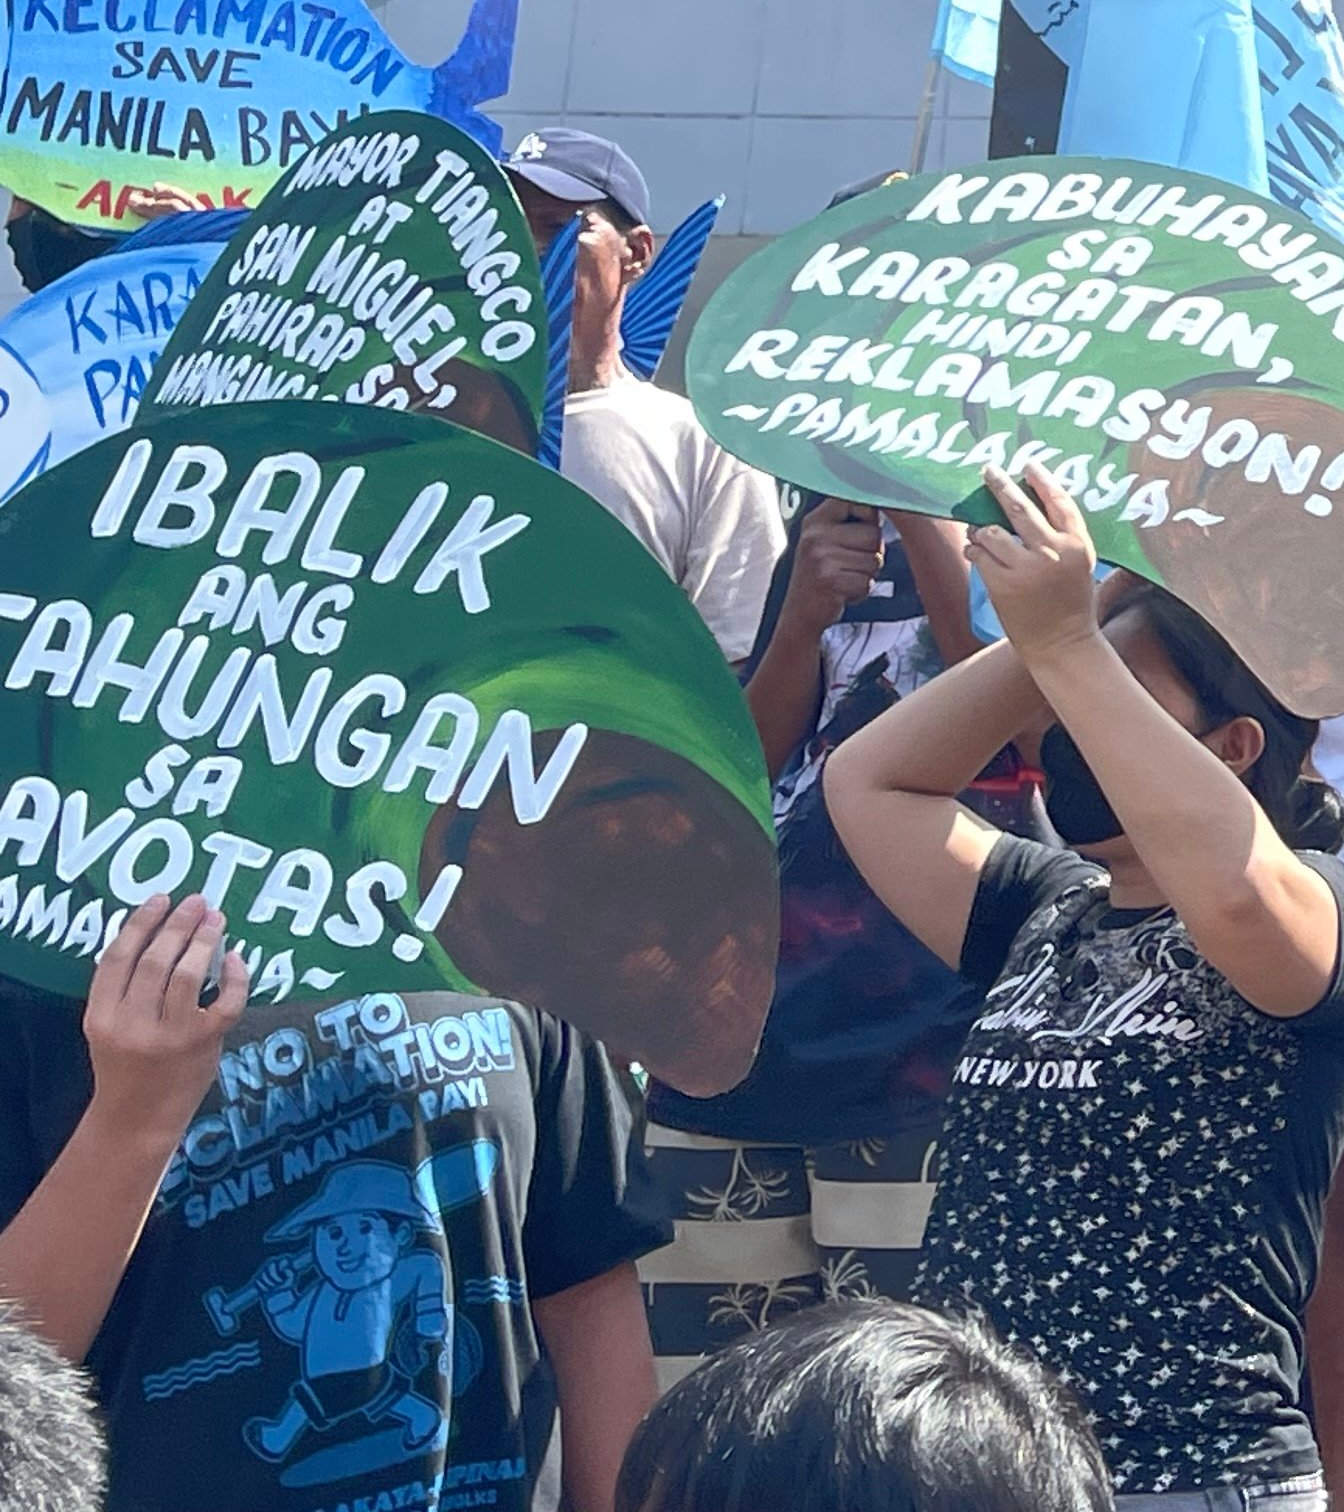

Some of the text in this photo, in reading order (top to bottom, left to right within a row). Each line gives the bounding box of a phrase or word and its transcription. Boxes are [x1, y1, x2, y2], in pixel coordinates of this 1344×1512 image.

[111, 40, 261, 89] SAVE
[6, 76, 216, 163] MANILA
[282, 131, 537, 363] MAYOR TIANGCO
[347, 193, 414, 244] AT
[1046, 228, 1155, 278] SA
[201, 290, 367, 374] PAHIRAP
[228, 222, 469, 409] SAN MIGUEL,
[790, 242, 1295, 385] KARAGATAN,
[903, 308, 1093, 367] HINDI
[91, 437, 532, 614] IBALIK
[177, 564, 355, 656] ANG
[125, 744, 244, 818] SA
[0, 775, 464, 963] AVOTAS!
[218, 992, 410, 1102] NO TO
[953, 1056, 1103, 1089] NEW YORK
[158, 1007, 516, 1192] ECLAMATION!
[183, 1076, 489, 1229] SAVE MANILA BAY!
